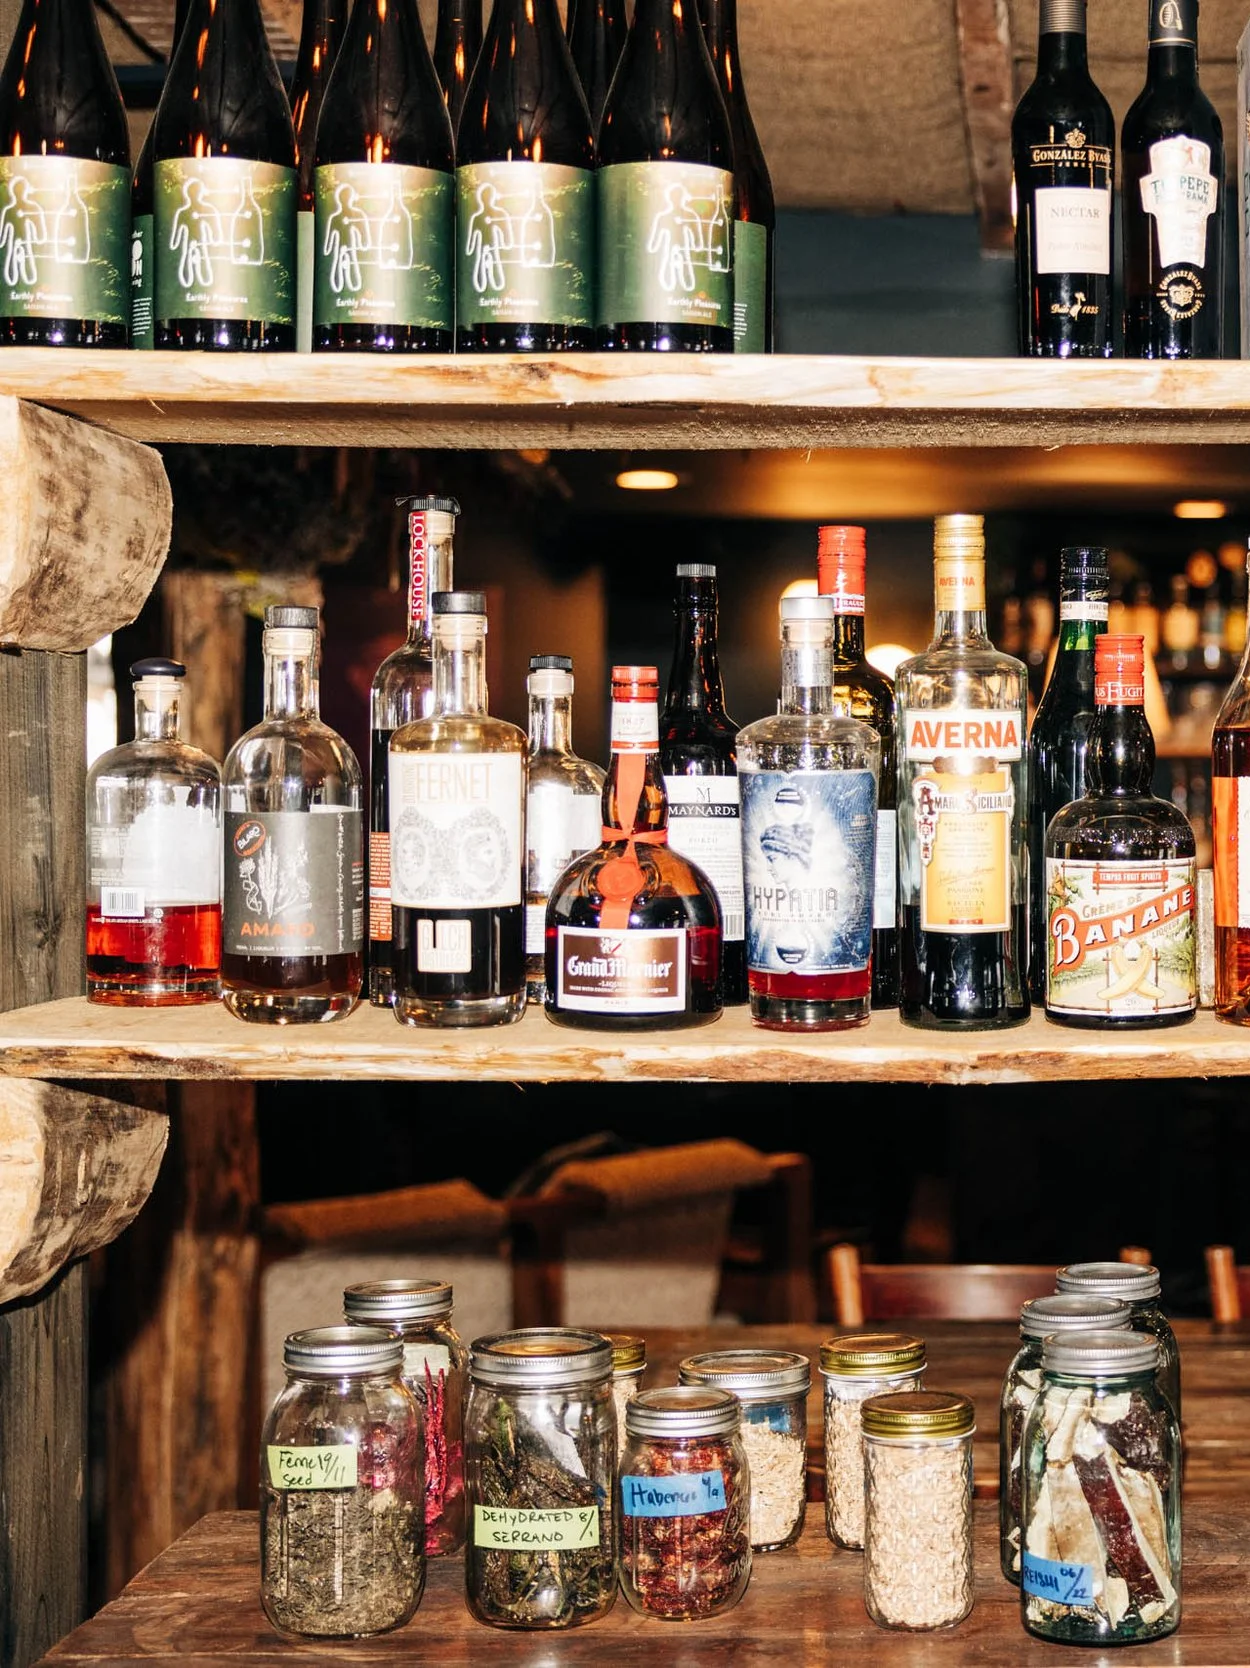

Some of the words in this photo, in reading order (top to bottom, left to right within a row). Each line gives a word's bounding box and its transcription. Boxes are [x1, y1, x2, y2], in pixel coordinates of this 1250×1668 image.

[1180, 176, 1210, 194] PEPE
[1051, 207, 1100, 219] NECTAR
[412, 515, 424, 617] LOCKHOUSE
[911, 720, 1018, 748] AVERNA
[415, 763, 492, 800] FERNET
[918, 785, 960, 815] AMAR
[753, 886, 839, 911] HYPATIA
[1127, 893, 1143, 906] DE
[1053, 889, 1192, 966] BANANE
[567, 956, 608, 978] Grand
[608, 957, 673, 978] Mnier
[492, 1530, 564, 1543] SERRANO
